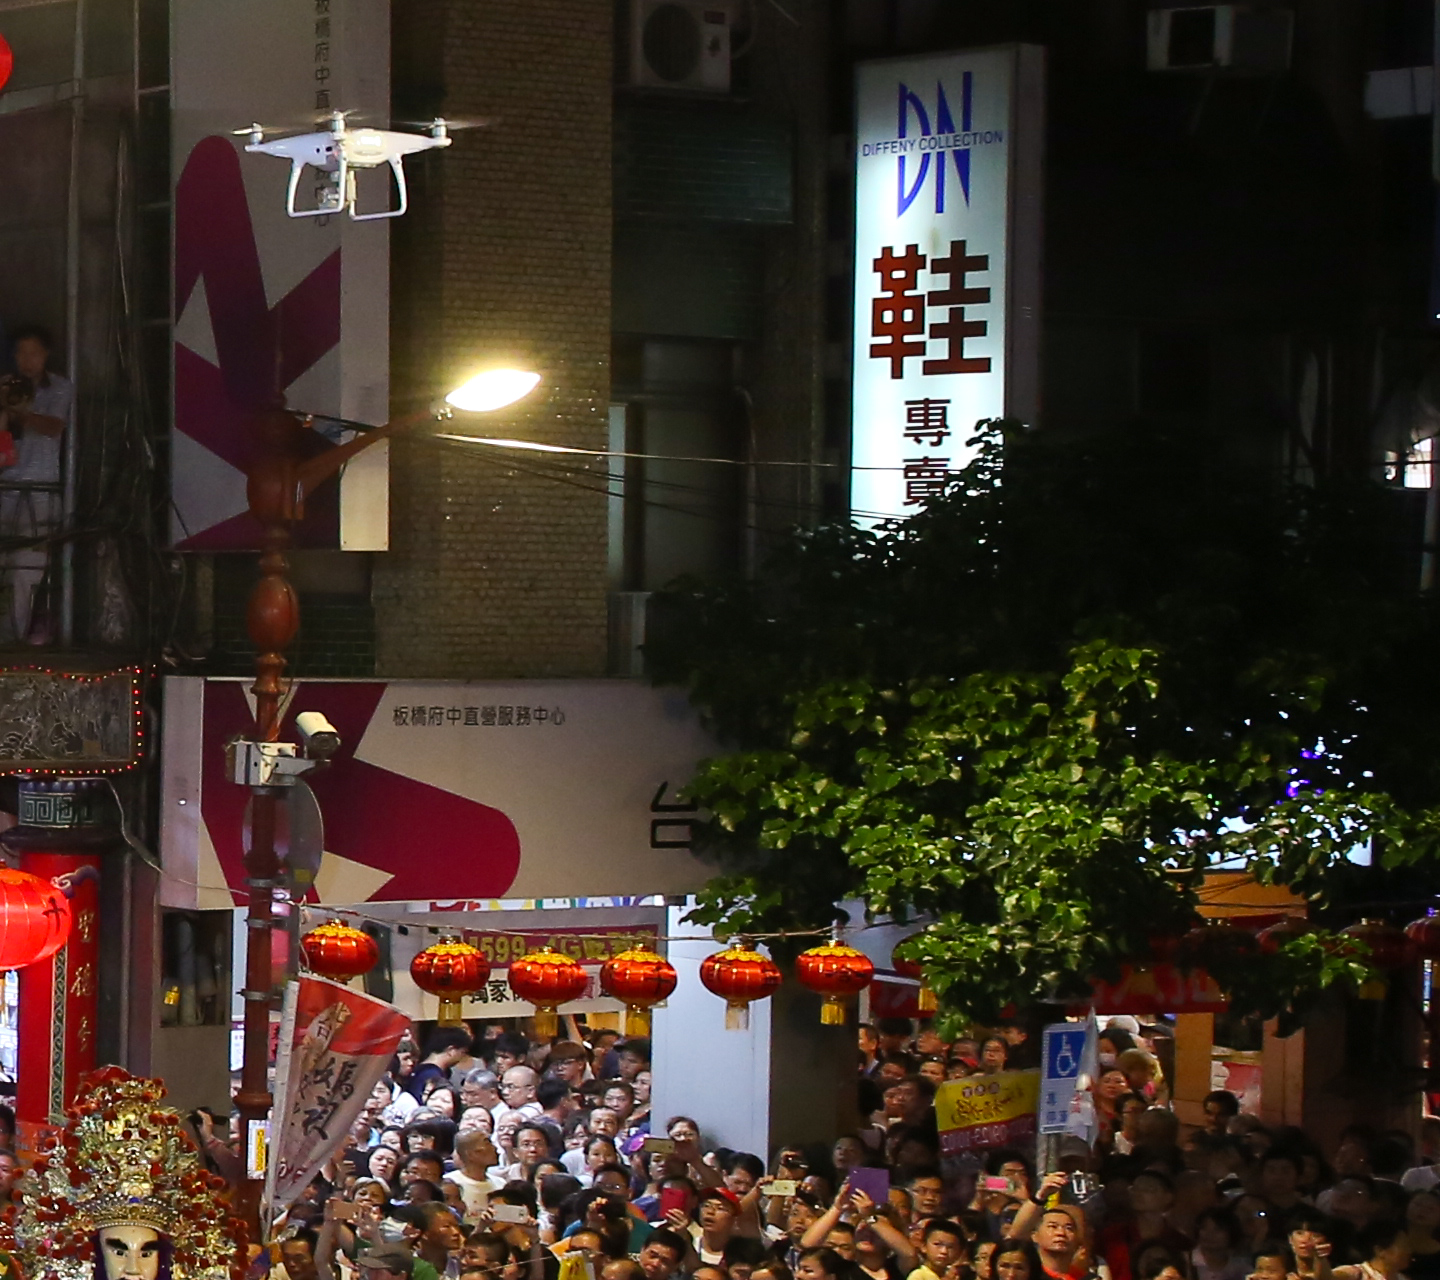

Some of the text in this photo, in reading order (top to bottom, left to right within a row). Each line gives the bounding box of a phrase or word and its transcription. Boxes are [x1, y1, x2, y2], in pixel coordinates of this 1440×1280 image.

[862, 130, 1003, 157] DIFFENY COLLECTION
[869, 239, 993, 380] 鞋
[392, 705, 566, 726] 板橋府中直營服務中心
